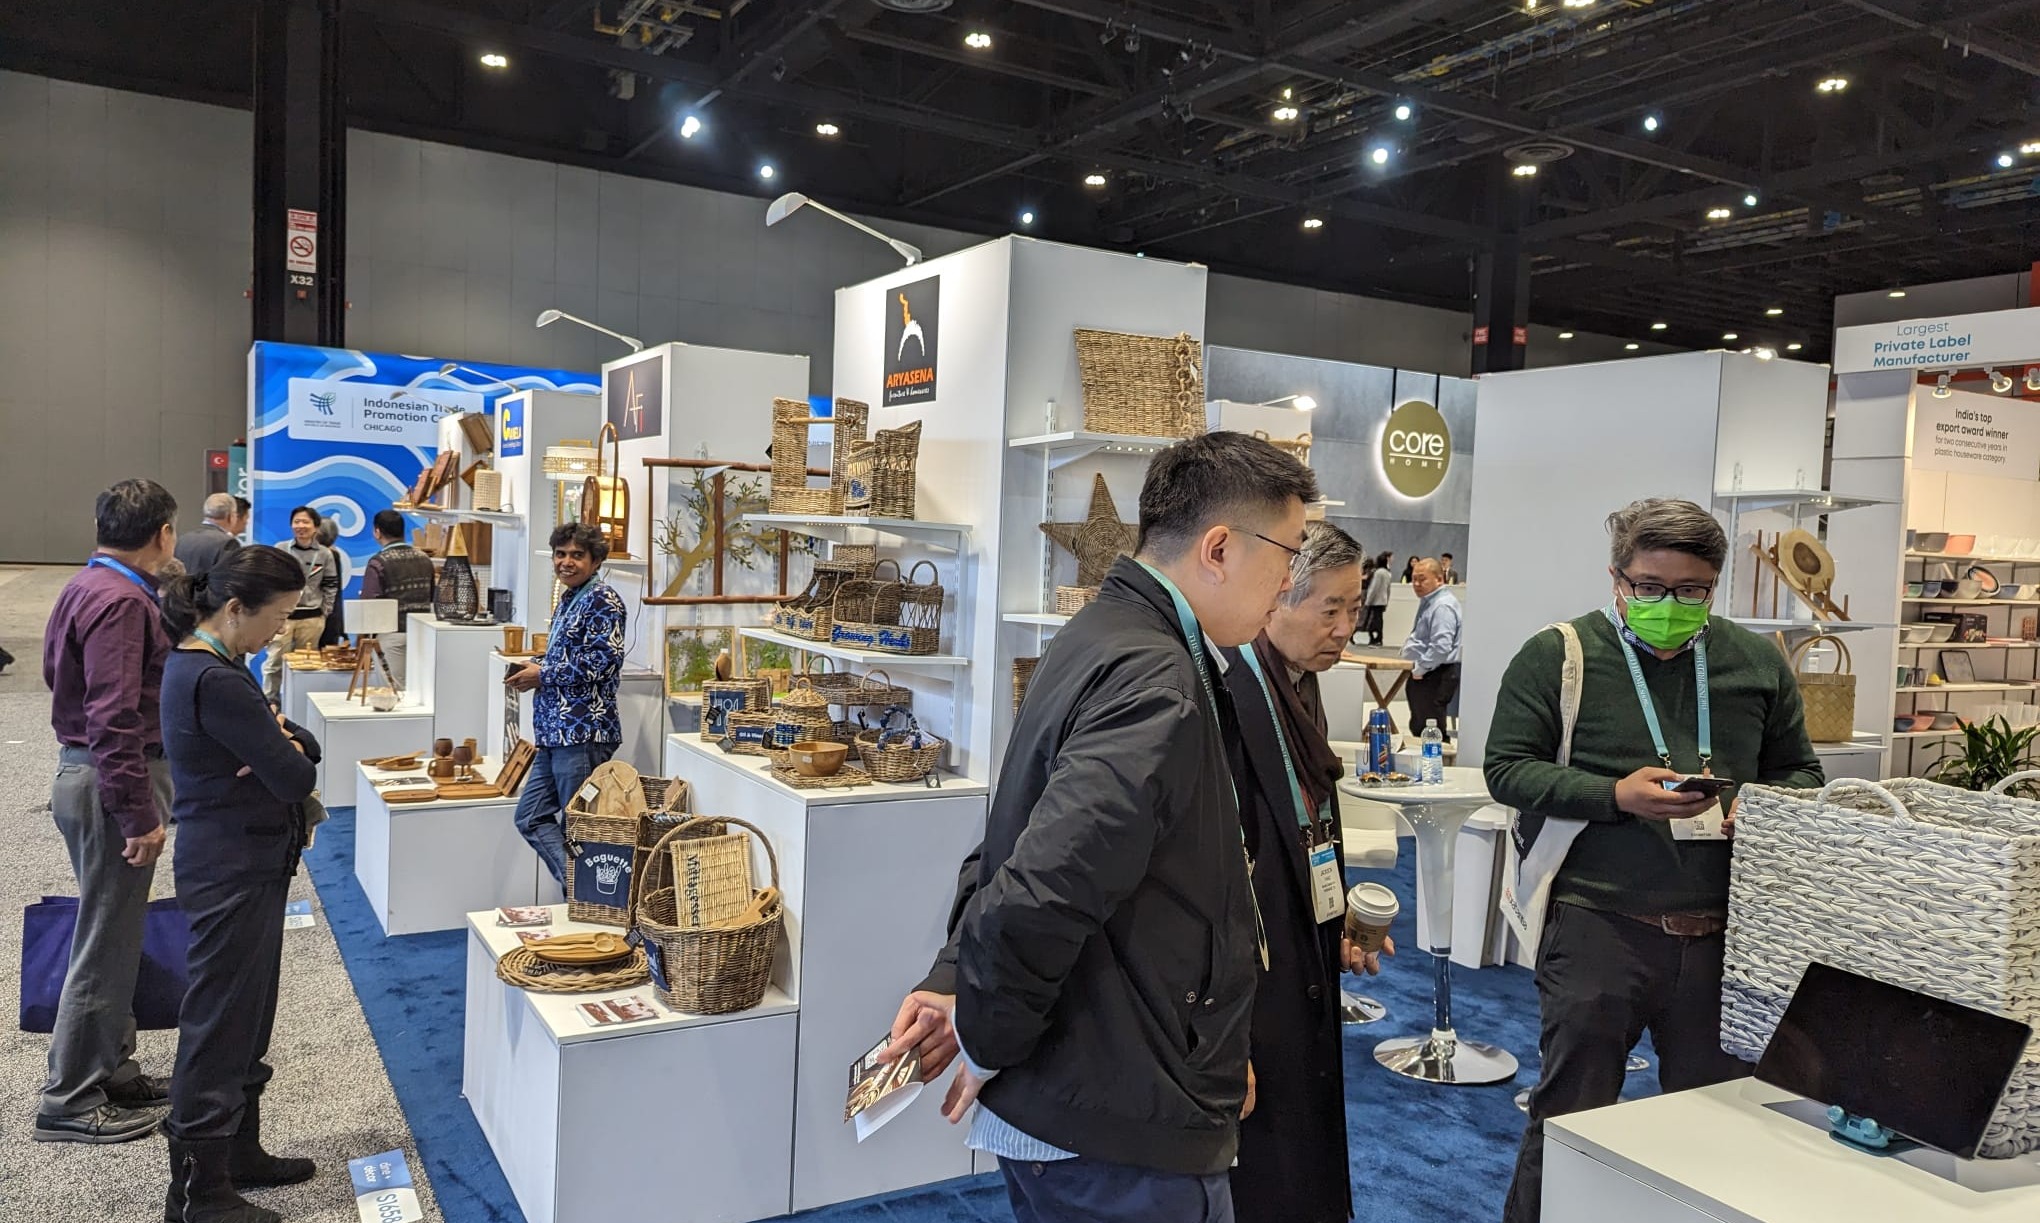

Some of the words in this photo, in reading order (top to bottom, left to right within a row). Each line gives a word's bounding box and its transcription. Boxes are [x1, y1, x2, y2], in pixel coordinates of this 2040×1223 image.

[290, 275, 314, 286] X32
[1896, 322, 1949, 336] Largest
[1874, 340, 1925, 353] Private
[1929, 333, 1971, 349] Label
[1873, 352, 1970, 367] Manufacturer
[886, 367, 934, 388] ARYASENA
[364, 398, 429, 412] Indonesian
[433, 403, 466, 413] Trde
[364, 410, 427, 423] Promotion
[1955, 408, 1979, 421] India's
[1980, 413, 1993, 425] top
[363, 423, 403, 433] CHICAGO
[1936, 423, 1960, 434] export
[1961, 426, 1984, 437] award
[1985, 428, 2009, 440] winner
[1389, 429, 1444, 456] core
[1935, 435, 1943, 444] for
[1943, 437, 1954, 445] two
[1389, 457, 1442, 470] HOME
[584, 853, 632, 874] Baguette
[376, 1193, 403, 1223] S1658
